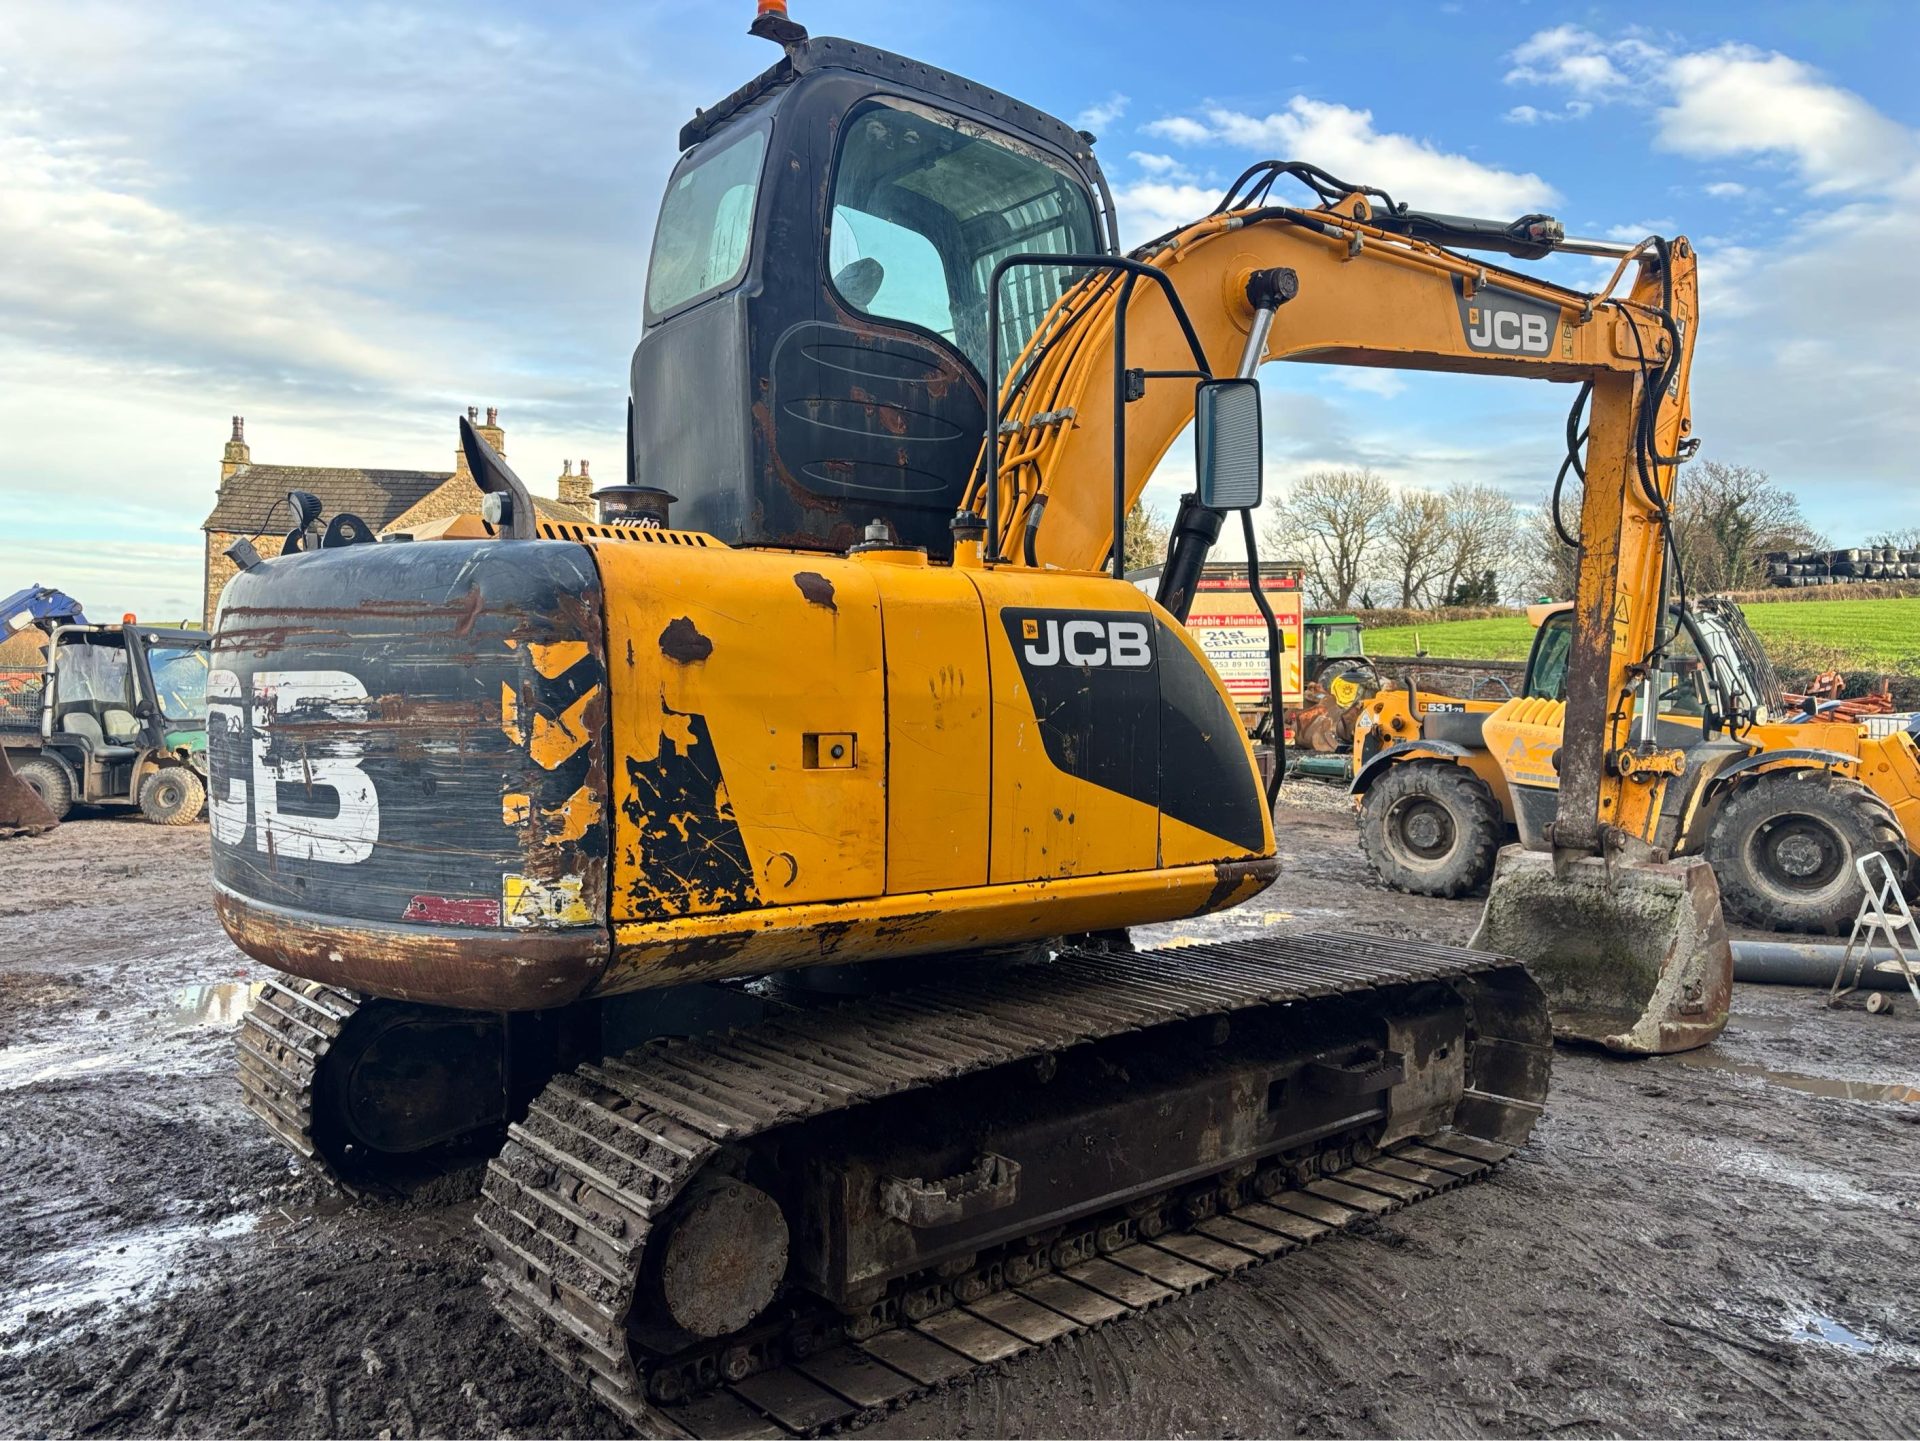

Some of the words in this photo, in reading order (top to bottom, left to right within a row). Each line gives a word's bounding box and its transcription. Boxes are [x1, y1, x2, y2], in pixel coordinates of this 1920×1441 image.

[1470, 310, 1548, 352] JCB
[611, 516, 661, 530] turbo
[1197, 580, 1221, 588] rdable
[1206, 630, 1246, 641] 21st
[1024, 620, 1151, 667] JCB
[1203, 636, 1267, 648] CENTURY
[1230, 651, 1267, 659] CENTRES
